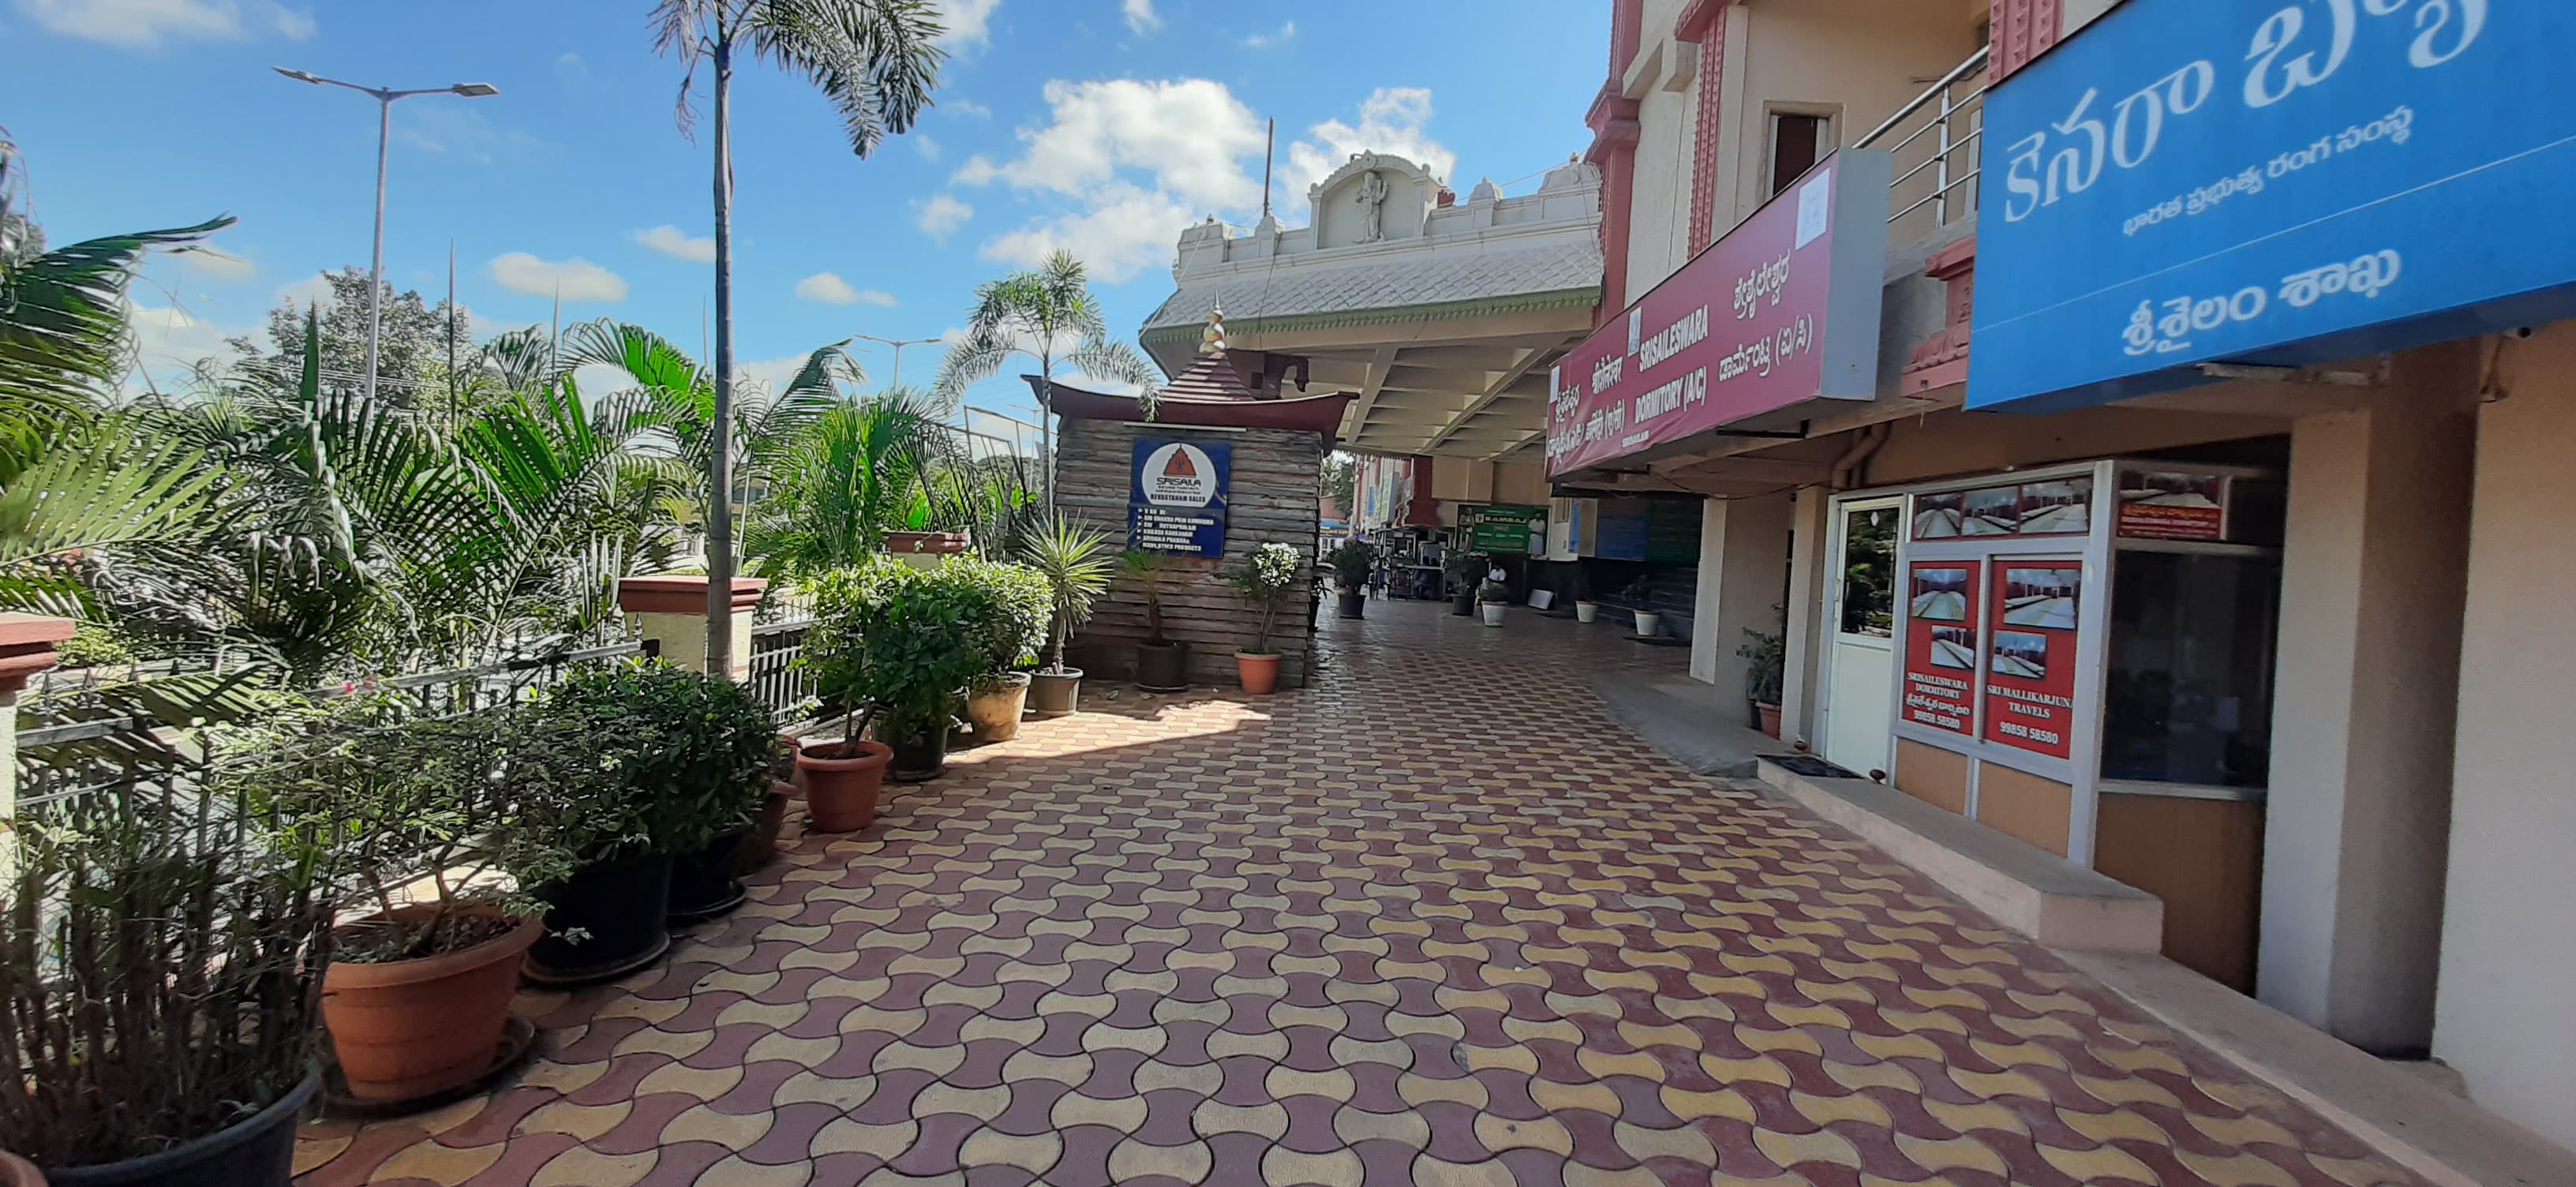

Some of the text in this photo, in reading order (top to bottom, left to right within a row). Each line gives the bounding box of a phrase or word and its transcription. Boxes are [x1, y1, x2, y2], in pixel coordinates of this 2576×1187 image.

[2005, 60, 2214, 222] కెనరా
[2124, 105, 2413, 235] భారత ప్రభుత్వ రంగ సంస్థ
[2278, 249, 2401, 308] శాఖ
[1639, 304, 1709, 373] SRISAILESWARA
[1634, 365, 1707, 424] DORMITORY (A/C)
[1908, 672, 1968, 690] SRISAILESWARA
[1987, 684, 2001, 695] SRI
[2009, 701, 2050, 719] TRAVELS
[2000, 721, 2058, 744] 99858 58580
